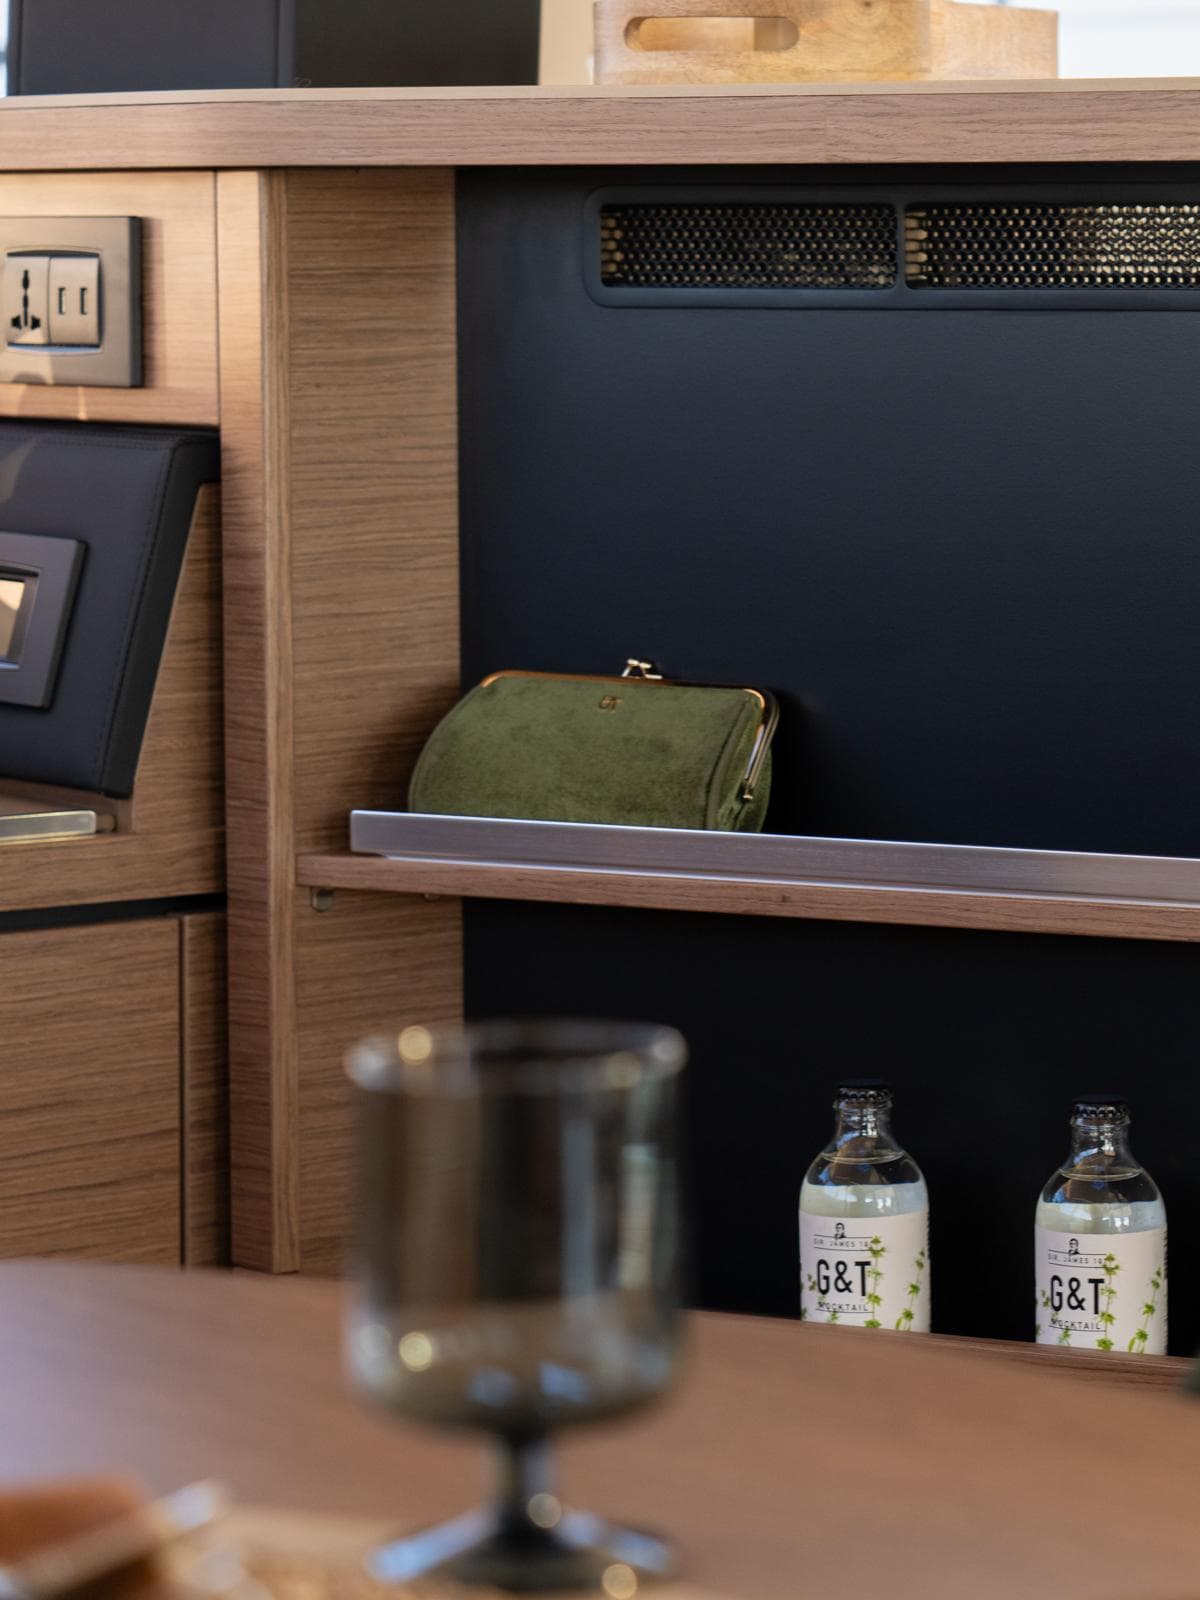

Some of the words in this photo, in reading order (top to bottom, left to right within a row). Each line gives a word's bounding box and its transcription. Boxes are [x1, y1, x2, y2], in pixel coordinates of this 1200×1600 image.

[830, 1240, 856, 1248] JAMES
[1063, 1256, 1089, 1264] JAMES
[817, 1259, 871, 1297] G&T
[1050, 1275, 1105, 1315] G&T
[817, 1301, 869, 1312] MOCKTAIL
[1050, 1318, 1101, 1330] MOCKTAIL
